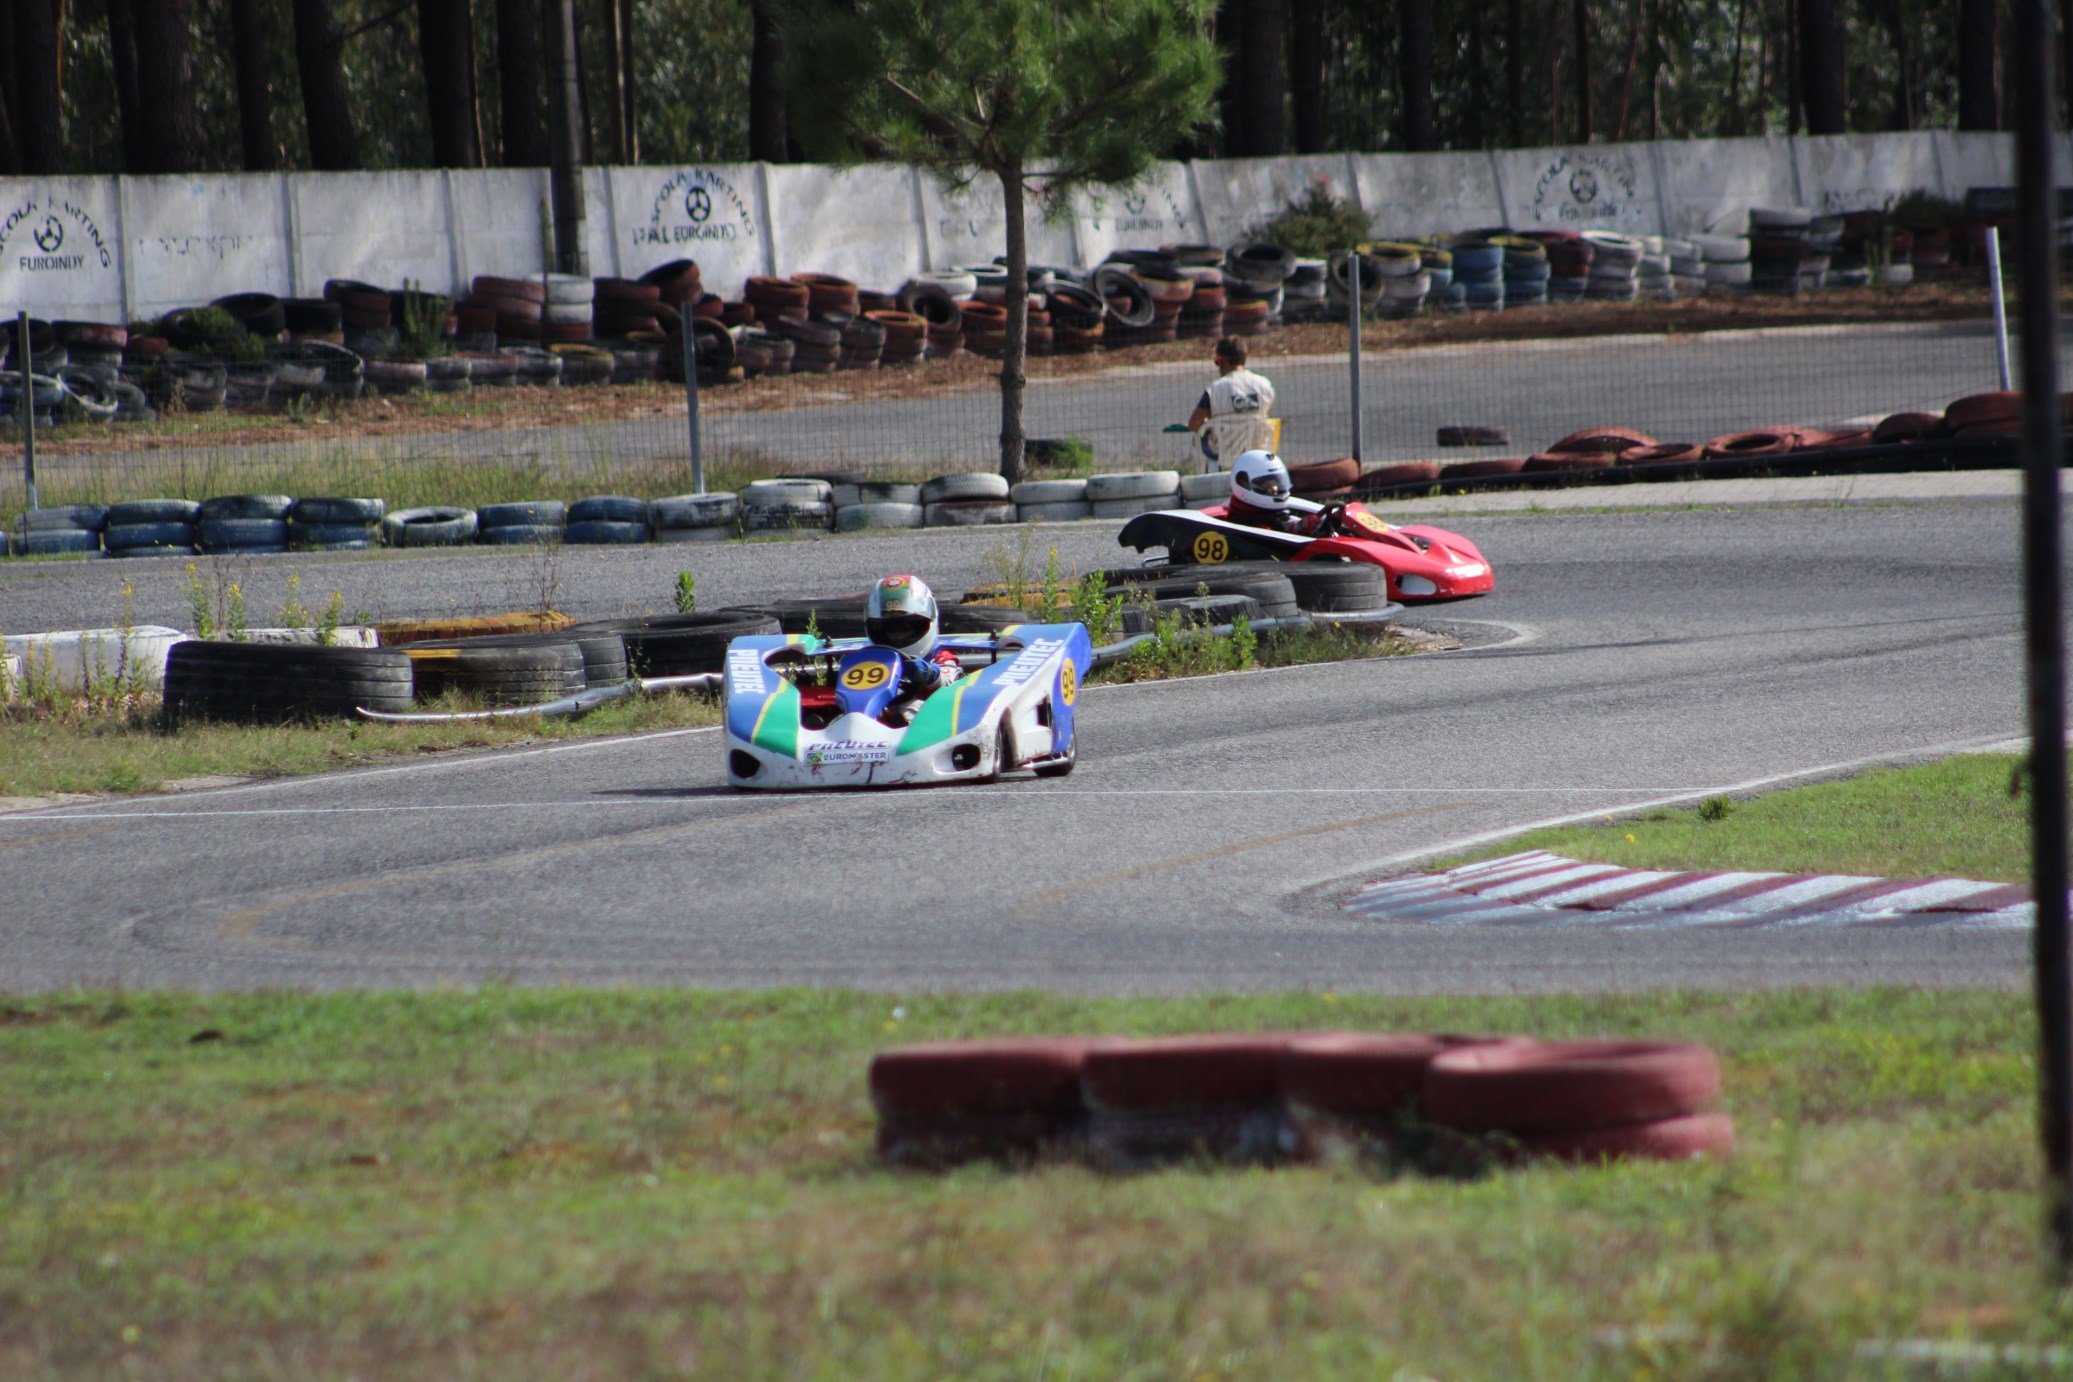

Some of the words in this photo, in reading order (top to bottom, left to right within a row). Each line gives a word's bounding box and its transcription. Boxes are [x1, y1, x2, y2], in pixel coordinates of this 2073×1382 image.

[1197, 537, 1224, 561] 98
[728, 649, 766, 694] PNEUTEC
[846, 666, 885, 686] 99
[991, 638, 1065, 686] PNEUTEC
[1062, 667, 1075, 700] 99
[823, 752, 887, 761] EUROMSTER
